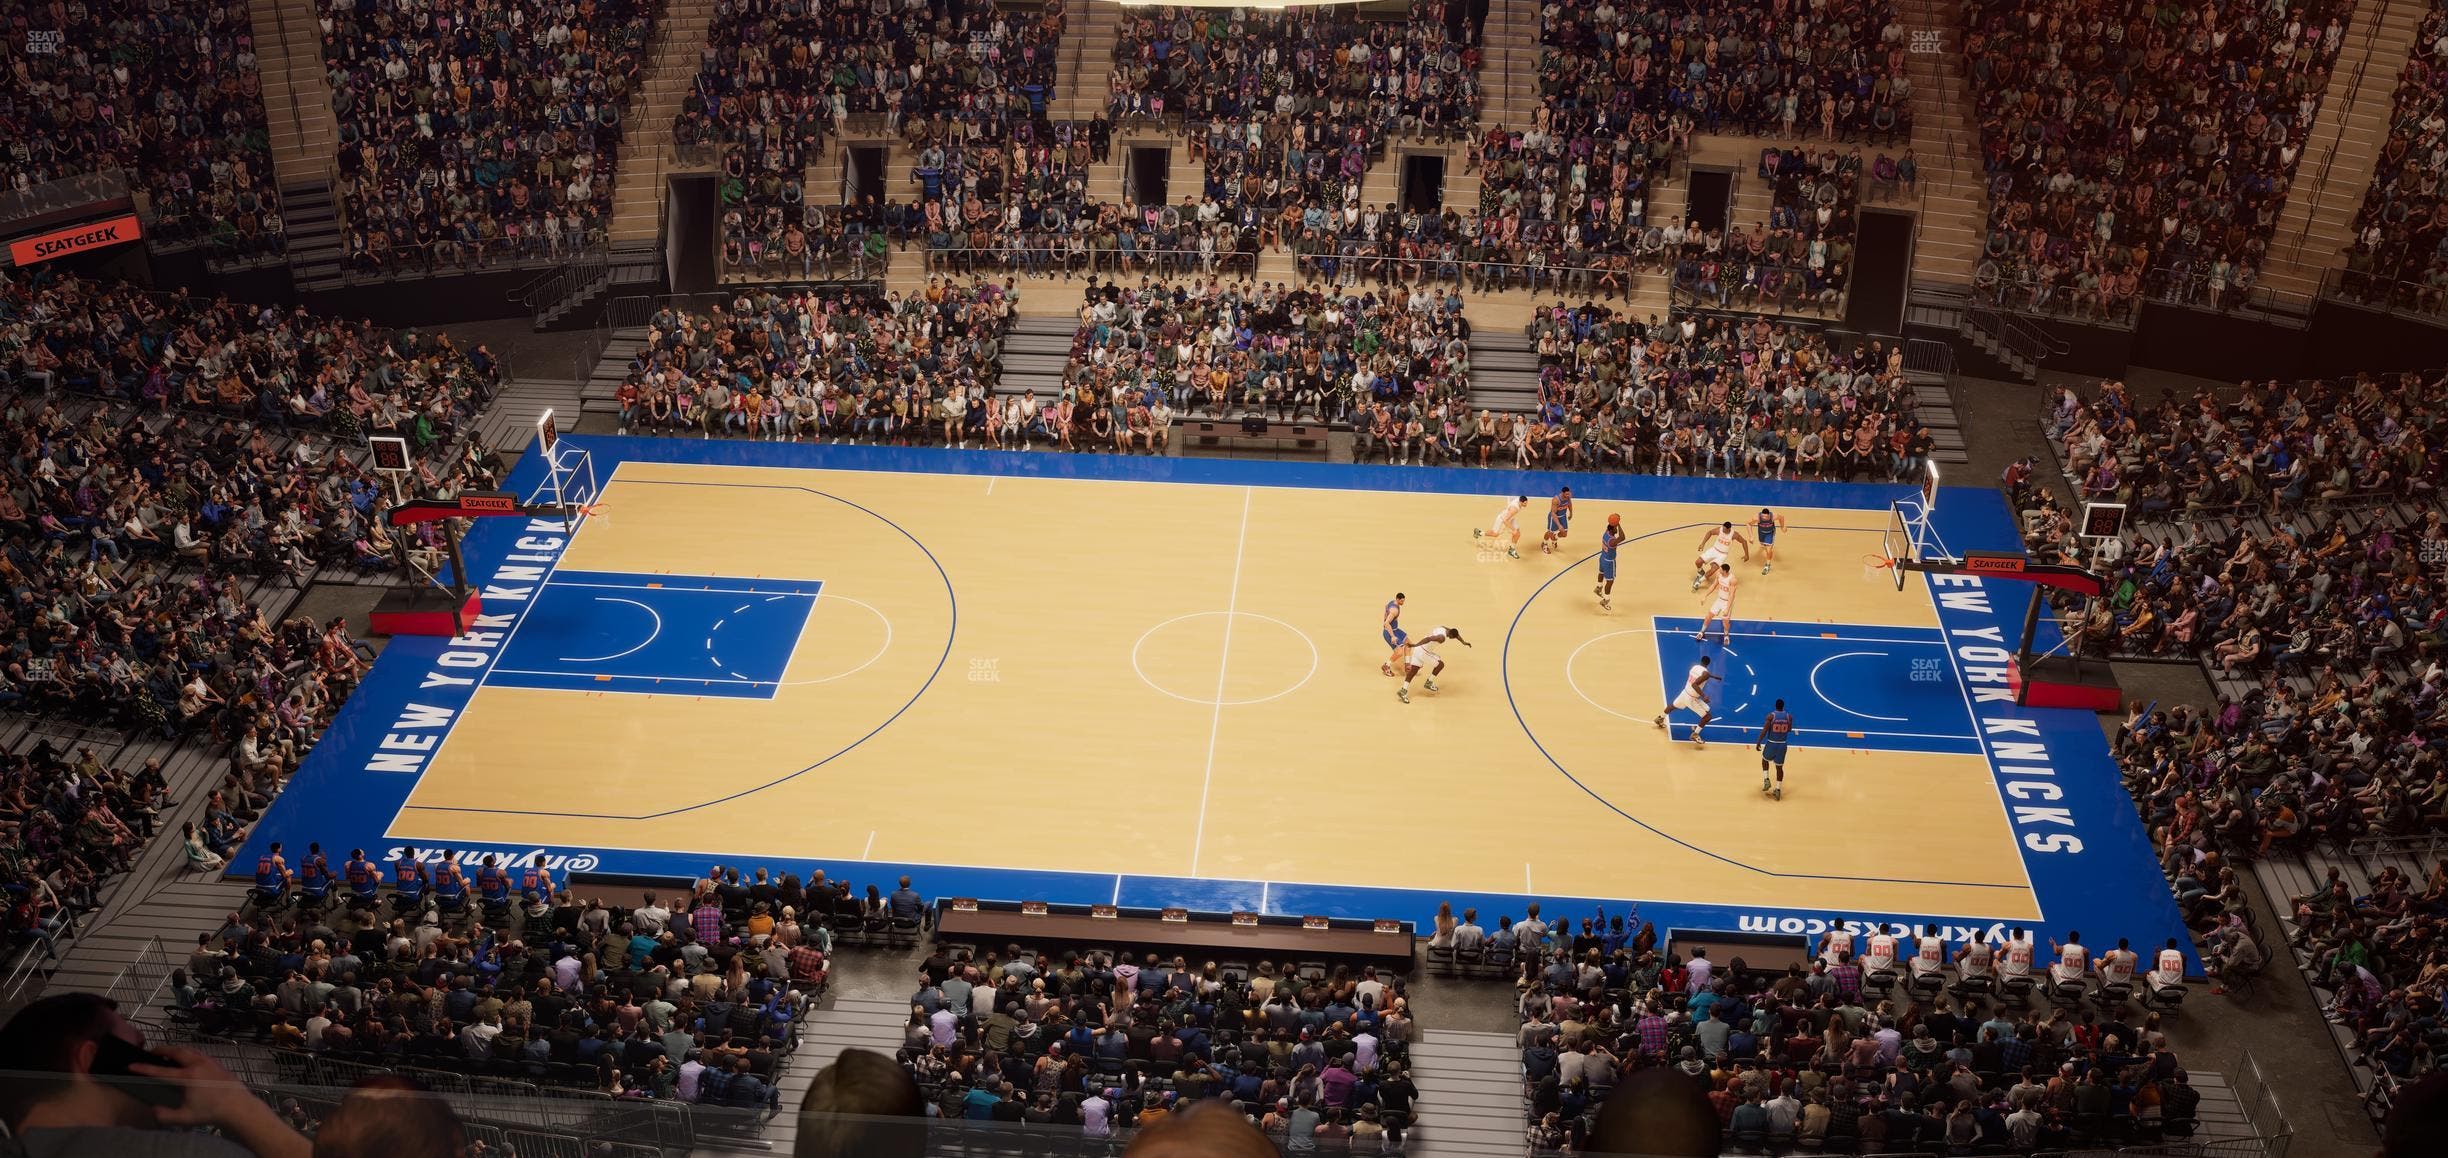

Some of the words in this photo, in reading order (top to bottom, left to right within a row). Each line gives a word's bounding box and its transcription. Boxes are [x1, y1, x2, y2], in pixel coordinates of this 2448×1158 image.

[34, 226, 120, 257] SEATGEEK
[465, 499, 508, 509] SEATGEEK
[1973, 560, 2017, 569] SEATGEEK
[1926, 557, 1993, 613] EW
[364, 703, 455, 773] NEW
[418, 613, 517, 688] YORK
[480, 501, 580, 600] KNICK
[1951, 626, 2016, 703] YORK
[1982, 718, 2084, 853] KNICKS
[1873, 944, 1890, 957] 00
[1922, 950, 1939, 961] 00
[2064, 957, 2082, 968] 00
[2162, 960, 2181, 972] 00
